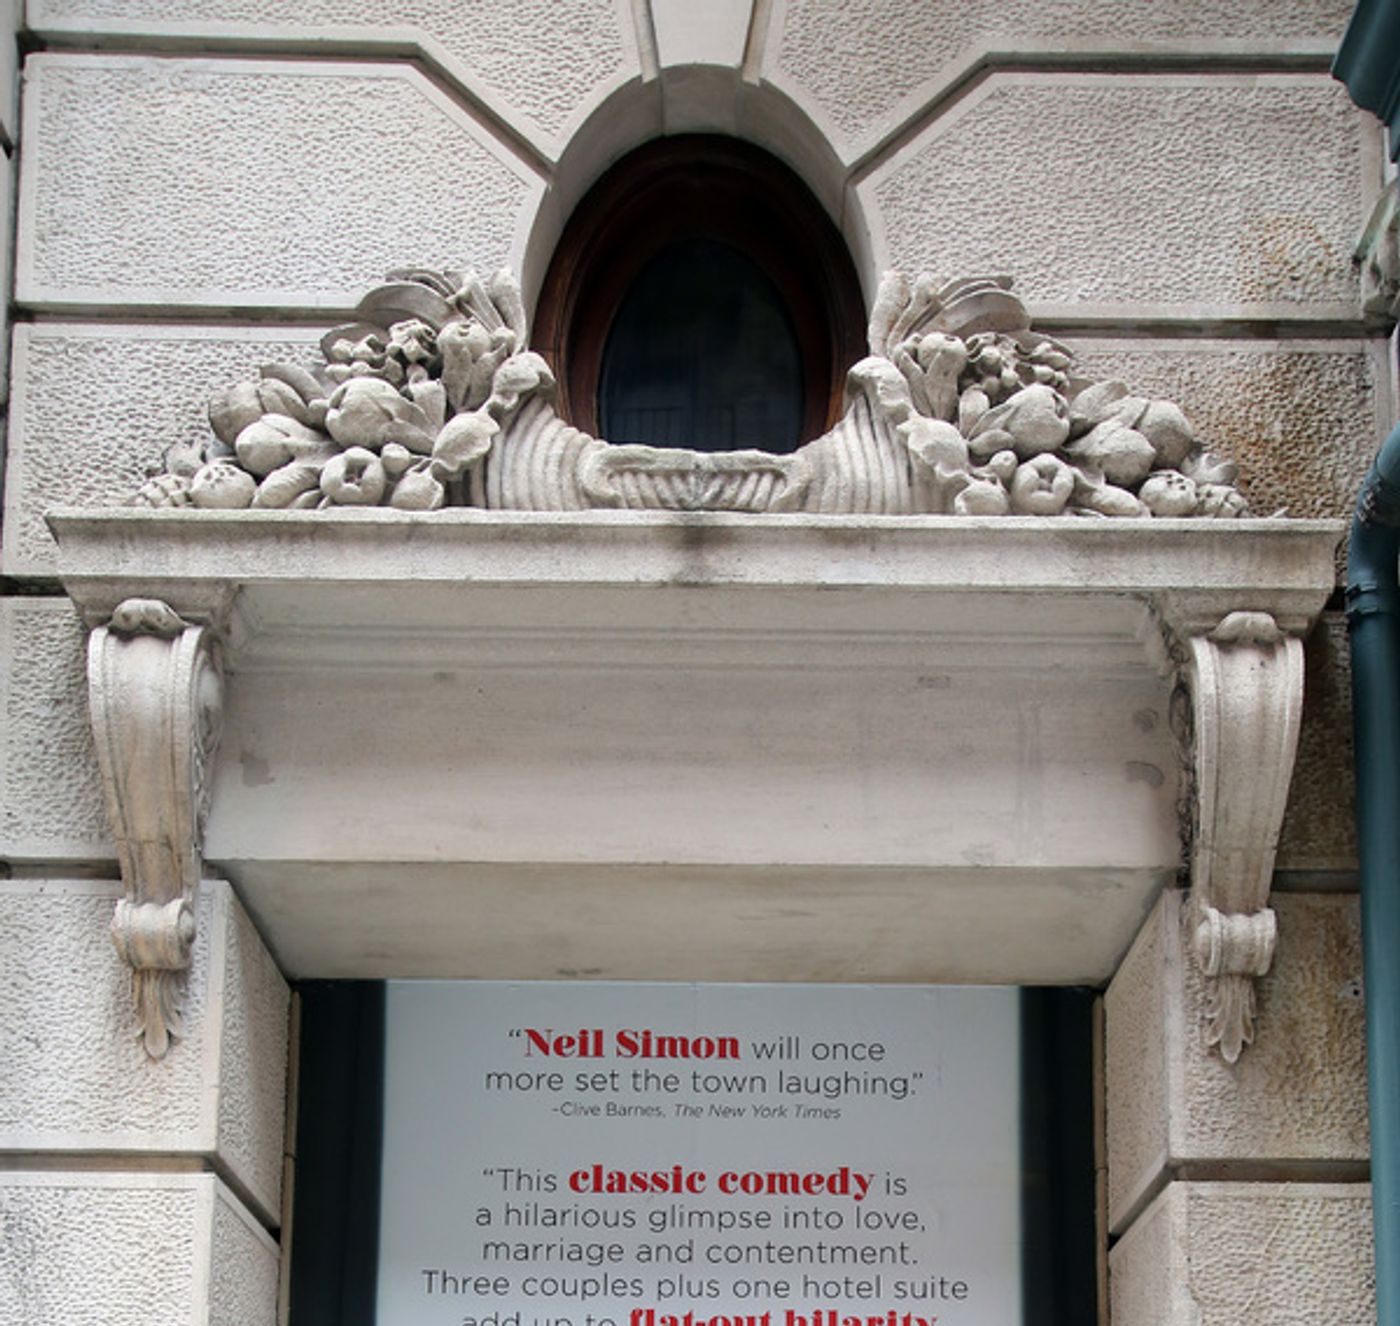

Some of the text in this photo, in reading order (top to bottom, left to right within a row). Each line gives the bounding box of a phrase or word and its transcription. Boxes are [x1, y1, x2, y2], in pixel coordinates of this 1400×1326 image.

[508, 1028, 886, 1063] “Neil Simon will once
[485, 1068, 924, 1101] more set the town laughing.”
[605, 1101, 667, 1119] Barnes,
[674, 1103, 704, 1119] The
[707, 1103, 747, 1119] New
[751, 1103, 789, 1119] York
[794, 1103, 842, 1120] Times
[482, 1163, 908, 1202] “This classic comedy is
[475, 1203, 926, 1234] a hilarious glimpse into love,
[482, 1237, 918, 1267] marriage and contentment.
[421, 1269, 969, 1302] Three couples plus one hotel suite
